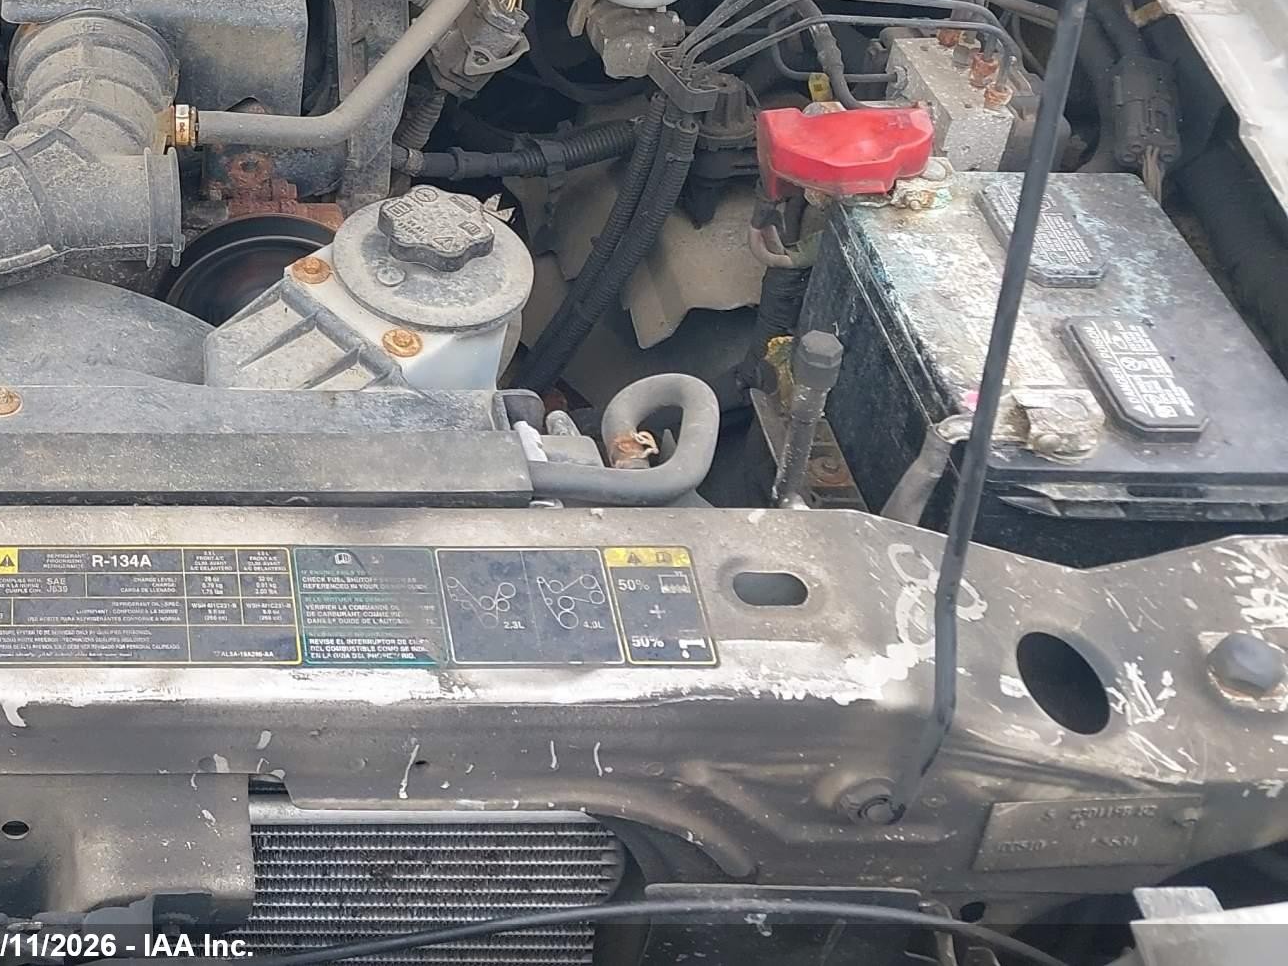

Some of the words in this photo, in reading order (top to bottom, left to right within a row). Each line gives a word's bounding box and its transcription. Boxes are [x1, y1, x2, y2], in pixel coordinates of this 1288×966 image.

[1083, 325, 1113, 359] POISON
[1108, 366, 1143, 404] DANGER
[92, 554, 152, 568] R-134A
[46, 577, 66, 585] SAE
[618, 578, 651, 592] 50%
[503, 621, 526, 629] 2.3L
[631, 635, 665, 648] 50%
